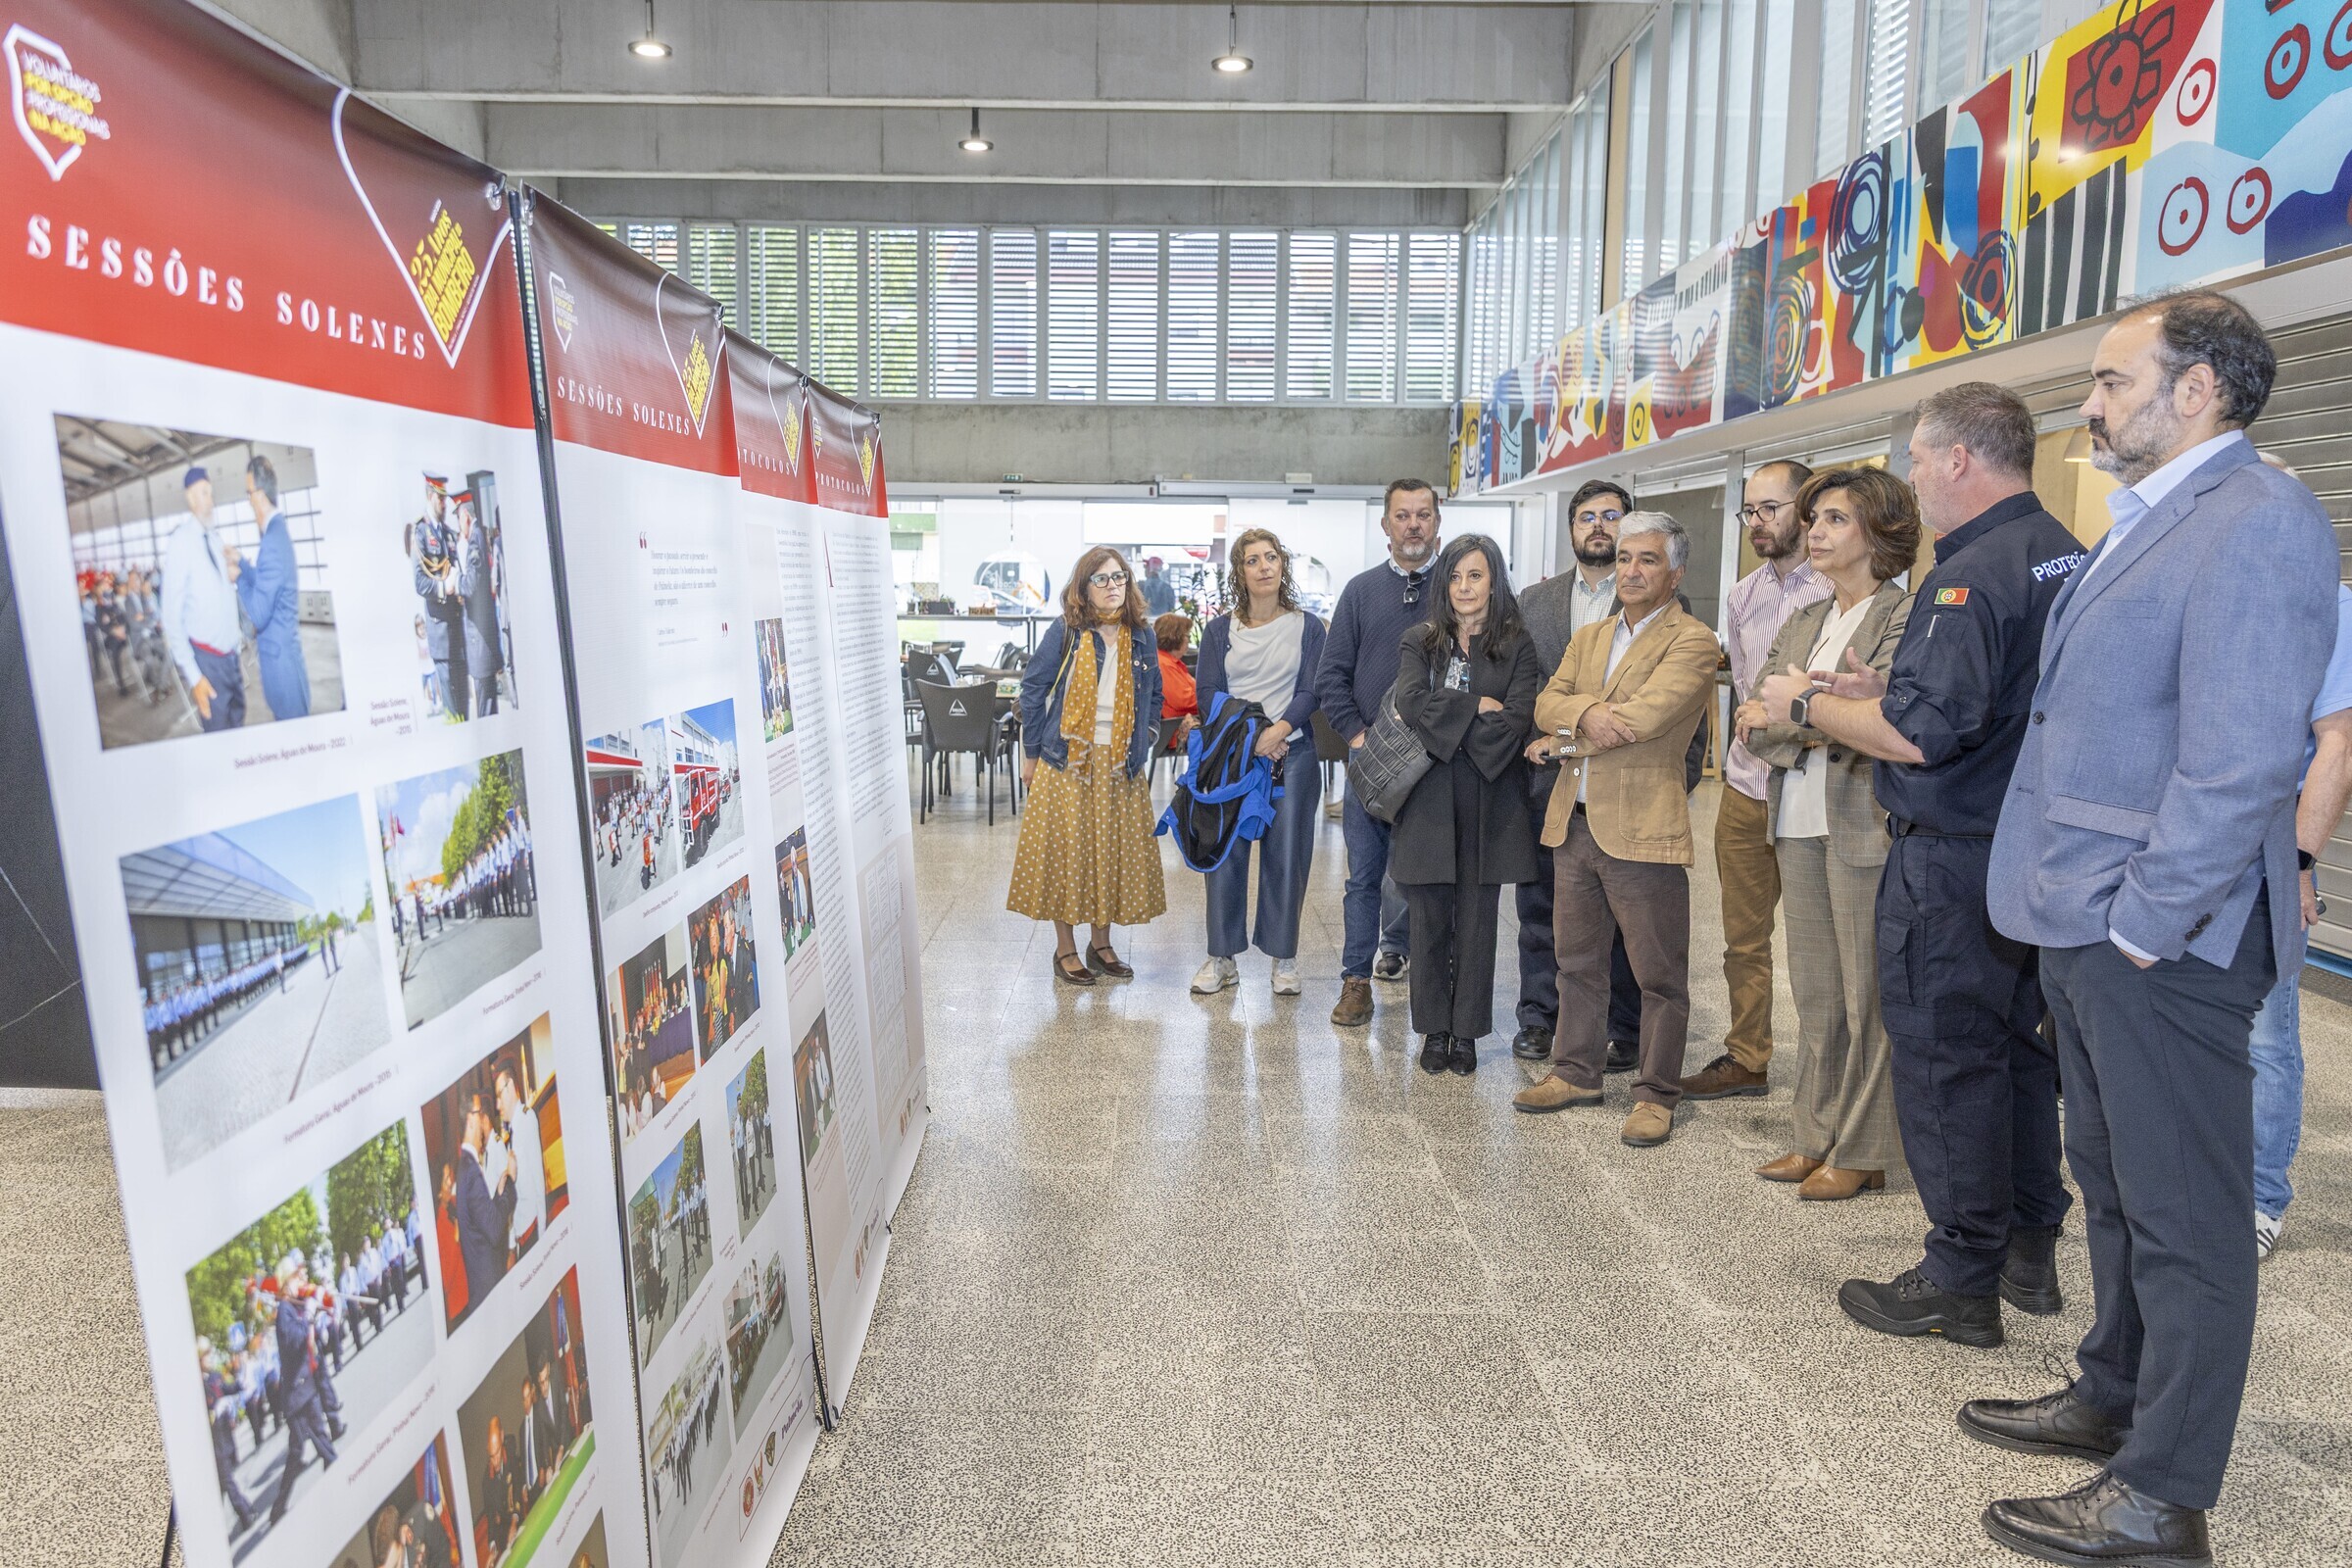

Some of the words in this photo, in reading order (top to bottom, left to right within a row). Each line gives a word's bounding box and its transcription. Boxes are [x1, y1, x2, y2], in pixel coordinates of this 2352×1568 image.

[27, 213, 244, 312] SESSÕES
[276, 292, 425, 361] SOLENES
[432, 246, 475, 343] BOMBEIRO
[557, 375, 623, 417] SESSÕES
[633, 402, 690, 436] SOLENES
[738, 448, 790, 475] TOCOLOS
[815, 470, 864, 496] PROTOCOLOS
